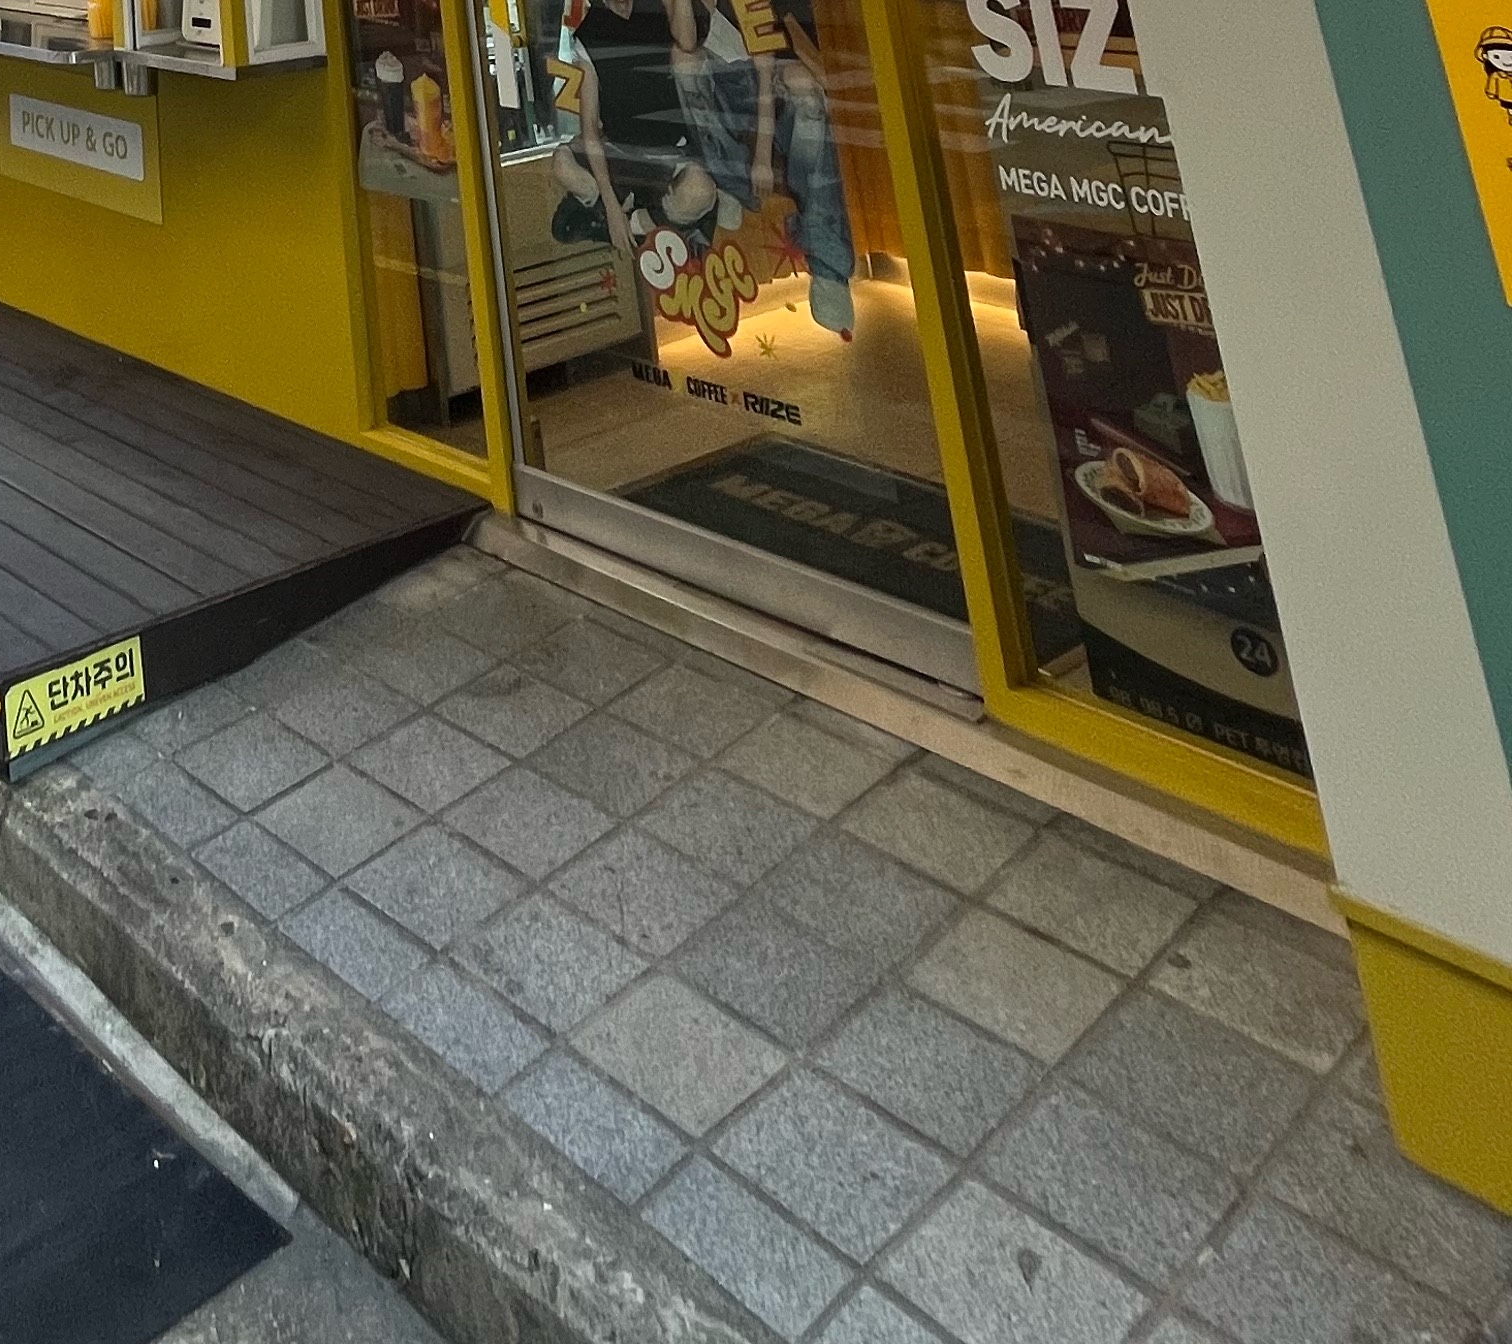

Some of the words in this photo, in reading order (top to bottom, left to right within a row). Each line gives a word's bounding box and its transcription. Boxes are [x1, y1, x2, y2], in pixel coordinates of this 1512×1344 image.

[21, 110, 56, 143] PICK
[59, 120, 81, 147] UP
[85, 126, 98, 152] &
[102, 131, 128, 160] GO
[998, 164, 1068, 201] MEGA
[1069, 176, 1126, 210] MGC
[686, 375, 728, 406] COFFEE
[1236, 634, 1272, 668] 24
[48, 647, 135, 711] 단차주의
